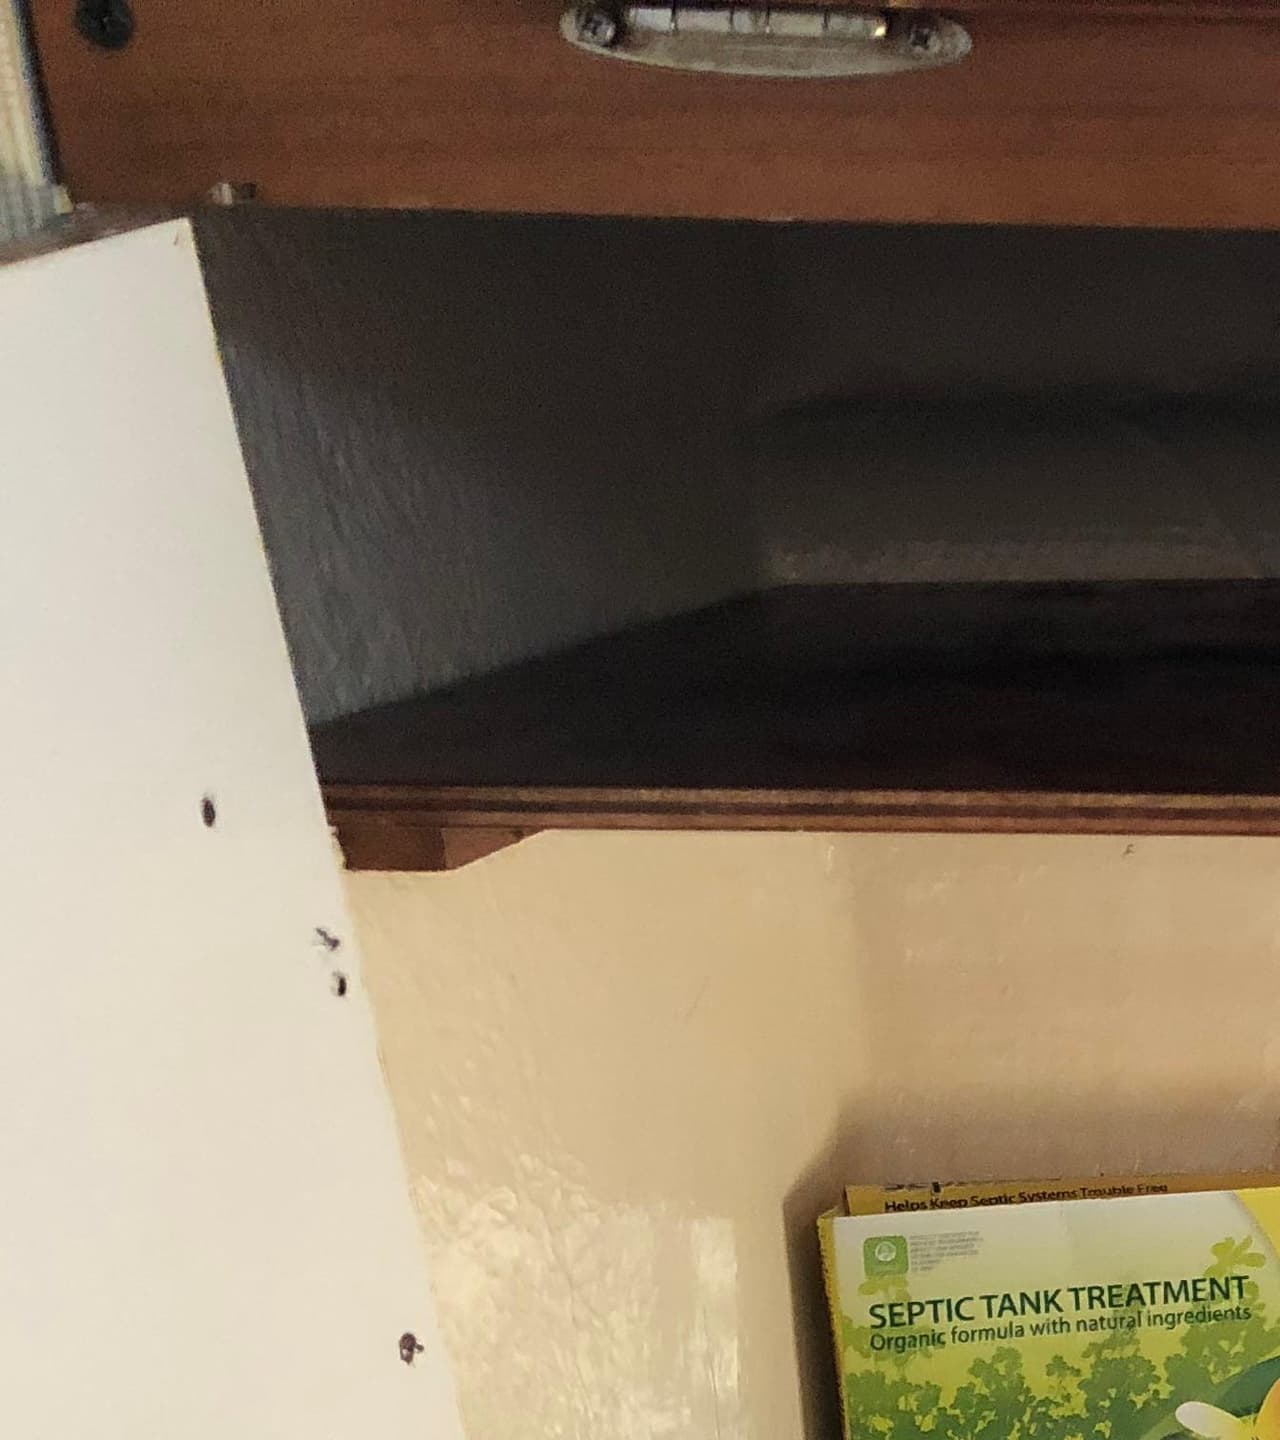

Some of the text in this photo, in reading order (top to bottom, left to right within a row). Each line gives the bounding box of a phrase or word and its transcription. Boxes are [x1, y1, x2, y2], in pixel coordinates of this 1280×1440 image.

[1019, 1188, 1079, 1203] Systems
[1080, 1183, 1135, 1199] Trouble
[869, 1275, 1250, 1329] SEPTIC TANK TREATMENT
[870, 1303, 1252, 1353] Organic formula with natural ingredients
